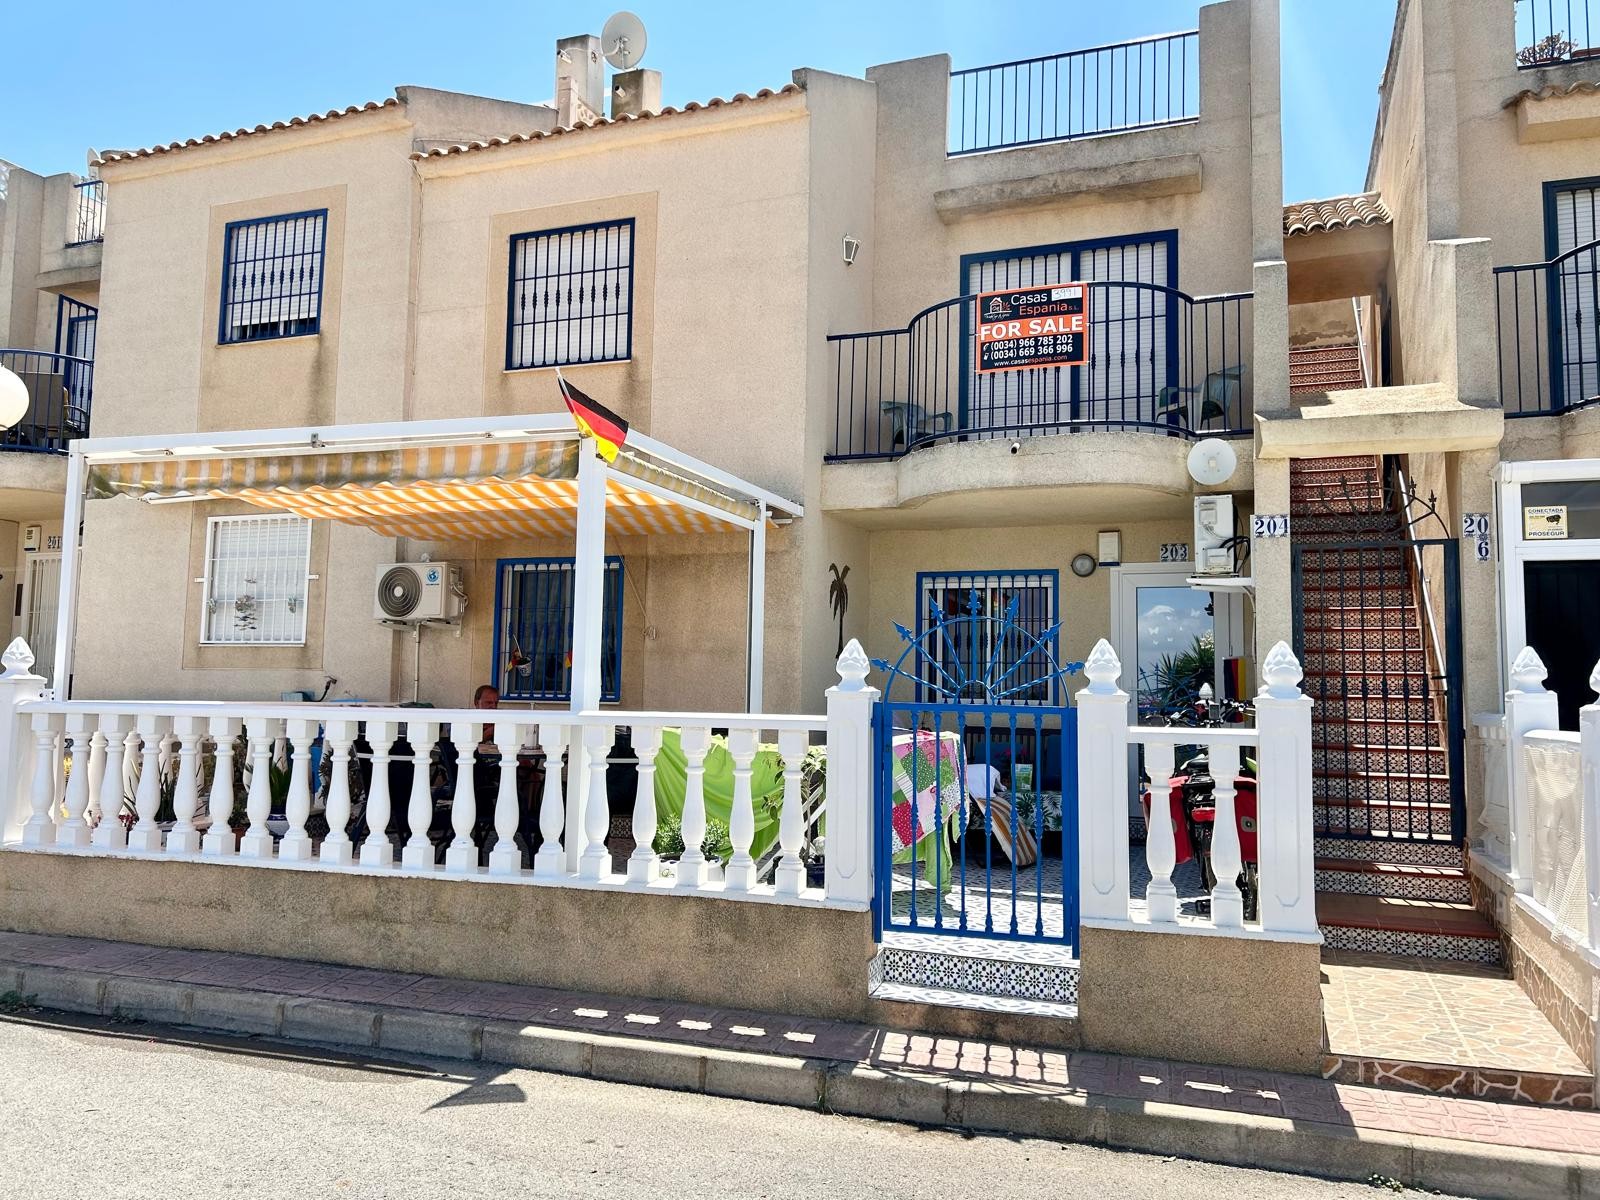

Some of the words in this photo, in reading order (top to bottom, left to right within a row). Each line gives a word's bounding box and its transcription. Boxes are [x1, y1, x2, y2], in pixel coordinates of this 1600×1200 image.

[1010, 293, 1048, 306] Casas
[1019, 302, 1068, 316] Espania
[980, 322, 1021, 341] FOR
[1029, 316, 1083, 335] SALE
[990, 339, 1017, 351] (0034)
[1019, 338, 1035, 347] 966
[1037, 336, 1054, 345] 785
[1056, 334, 1073, 344] 202
[990, 348, 1017, 360] (0034)
[1019, 347, 1035, 357] 669
[1037, 345, 1054, 355] 366
[1056, 343, 1073, 353] 996
[994, 354, 1068, 367] www.casasespania.com
[1254, 518, 1289, 535] 204
[1160, 546, 1188, 560] 203
[1477, 541, 1489, 557] 6
